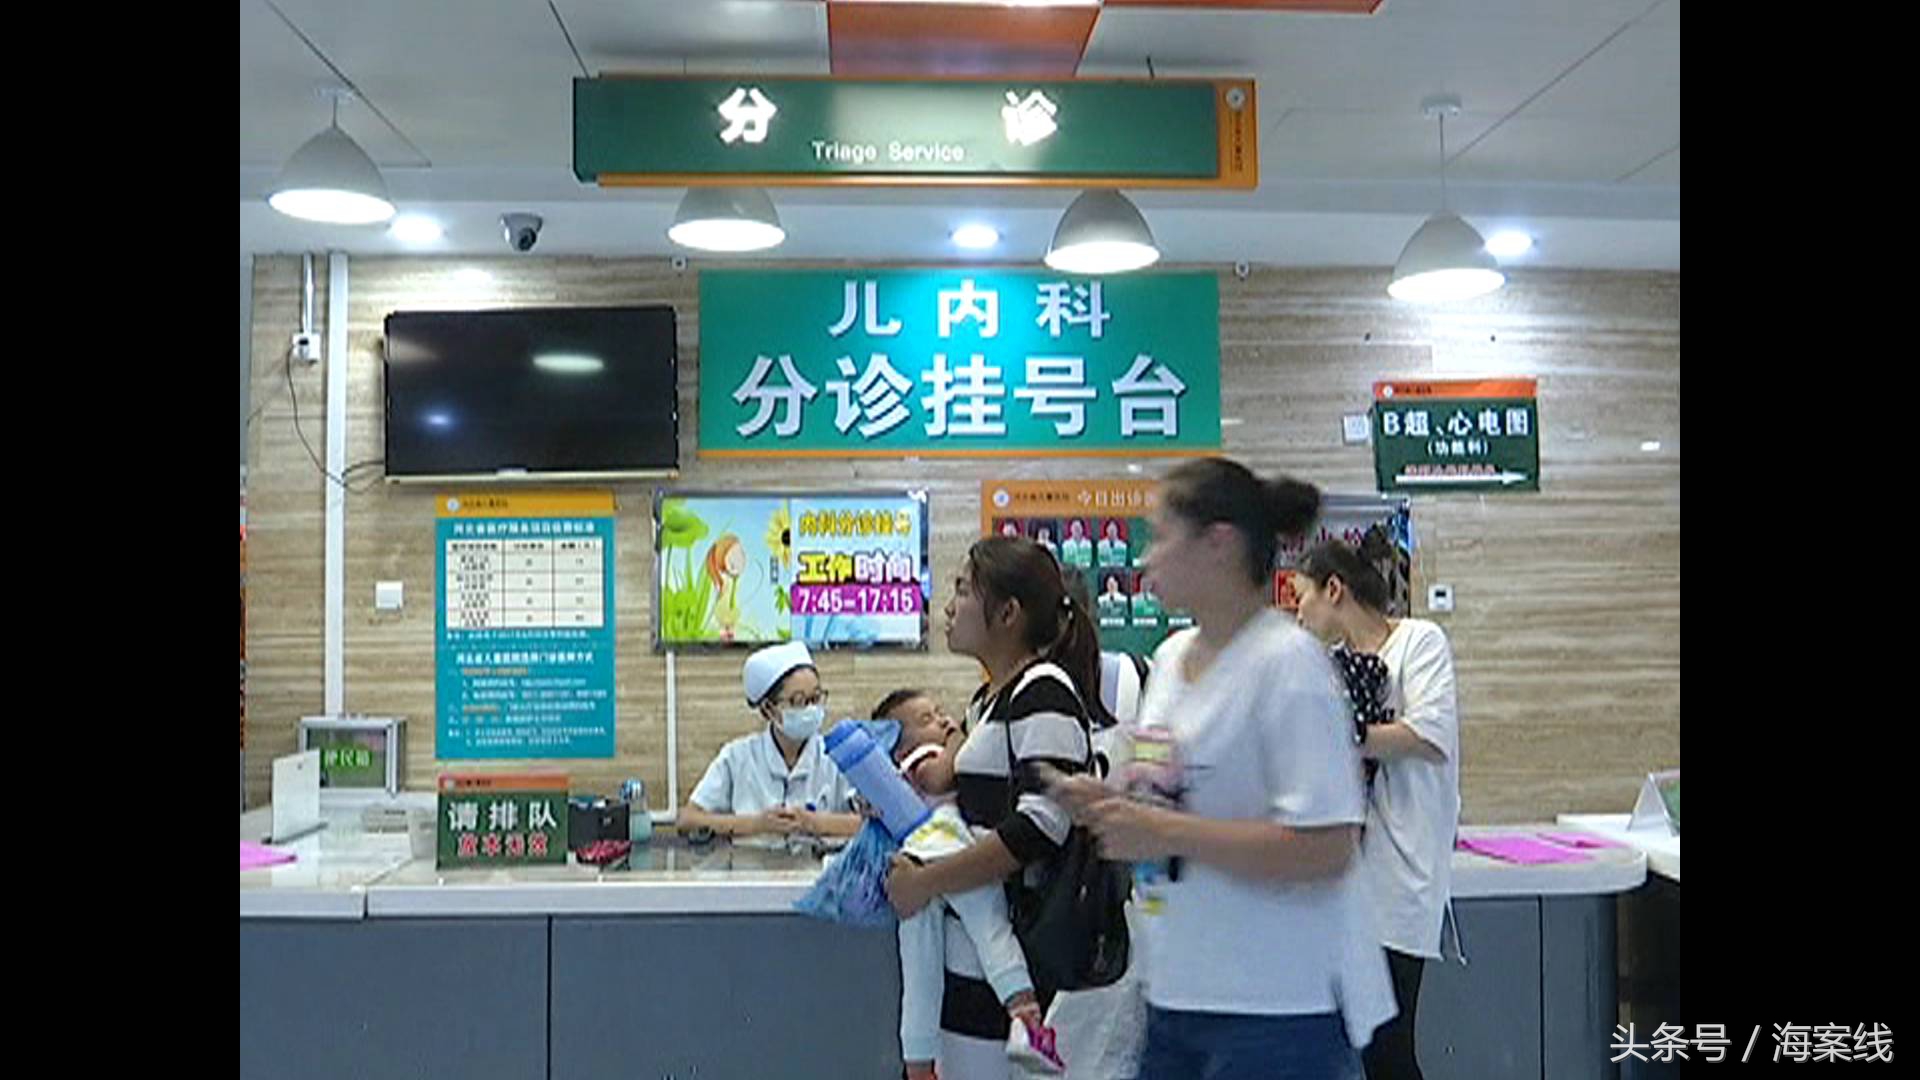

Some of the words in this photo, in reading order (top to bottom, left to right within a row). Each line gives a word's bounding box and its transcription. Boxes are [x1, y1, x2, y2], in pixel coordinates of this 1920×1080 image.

[717, 87, 1058, 146] 分诊
[811, 140, 878, 164] Triage
[887, 139, 965, 161] Service
[828, 280, 1111, 339] 儿内科
[732, 353, 1187, 438] 分诊挂号台
[1382, 407, 1529, 437] B超、心电图
[799, 508, 912, 537] 内科分诊挂号
[797, 549, 915, 584] 工作时间
[799, 588, 914, 613] 7:45-17:15
[448, 799, 557, 831] 请排队
